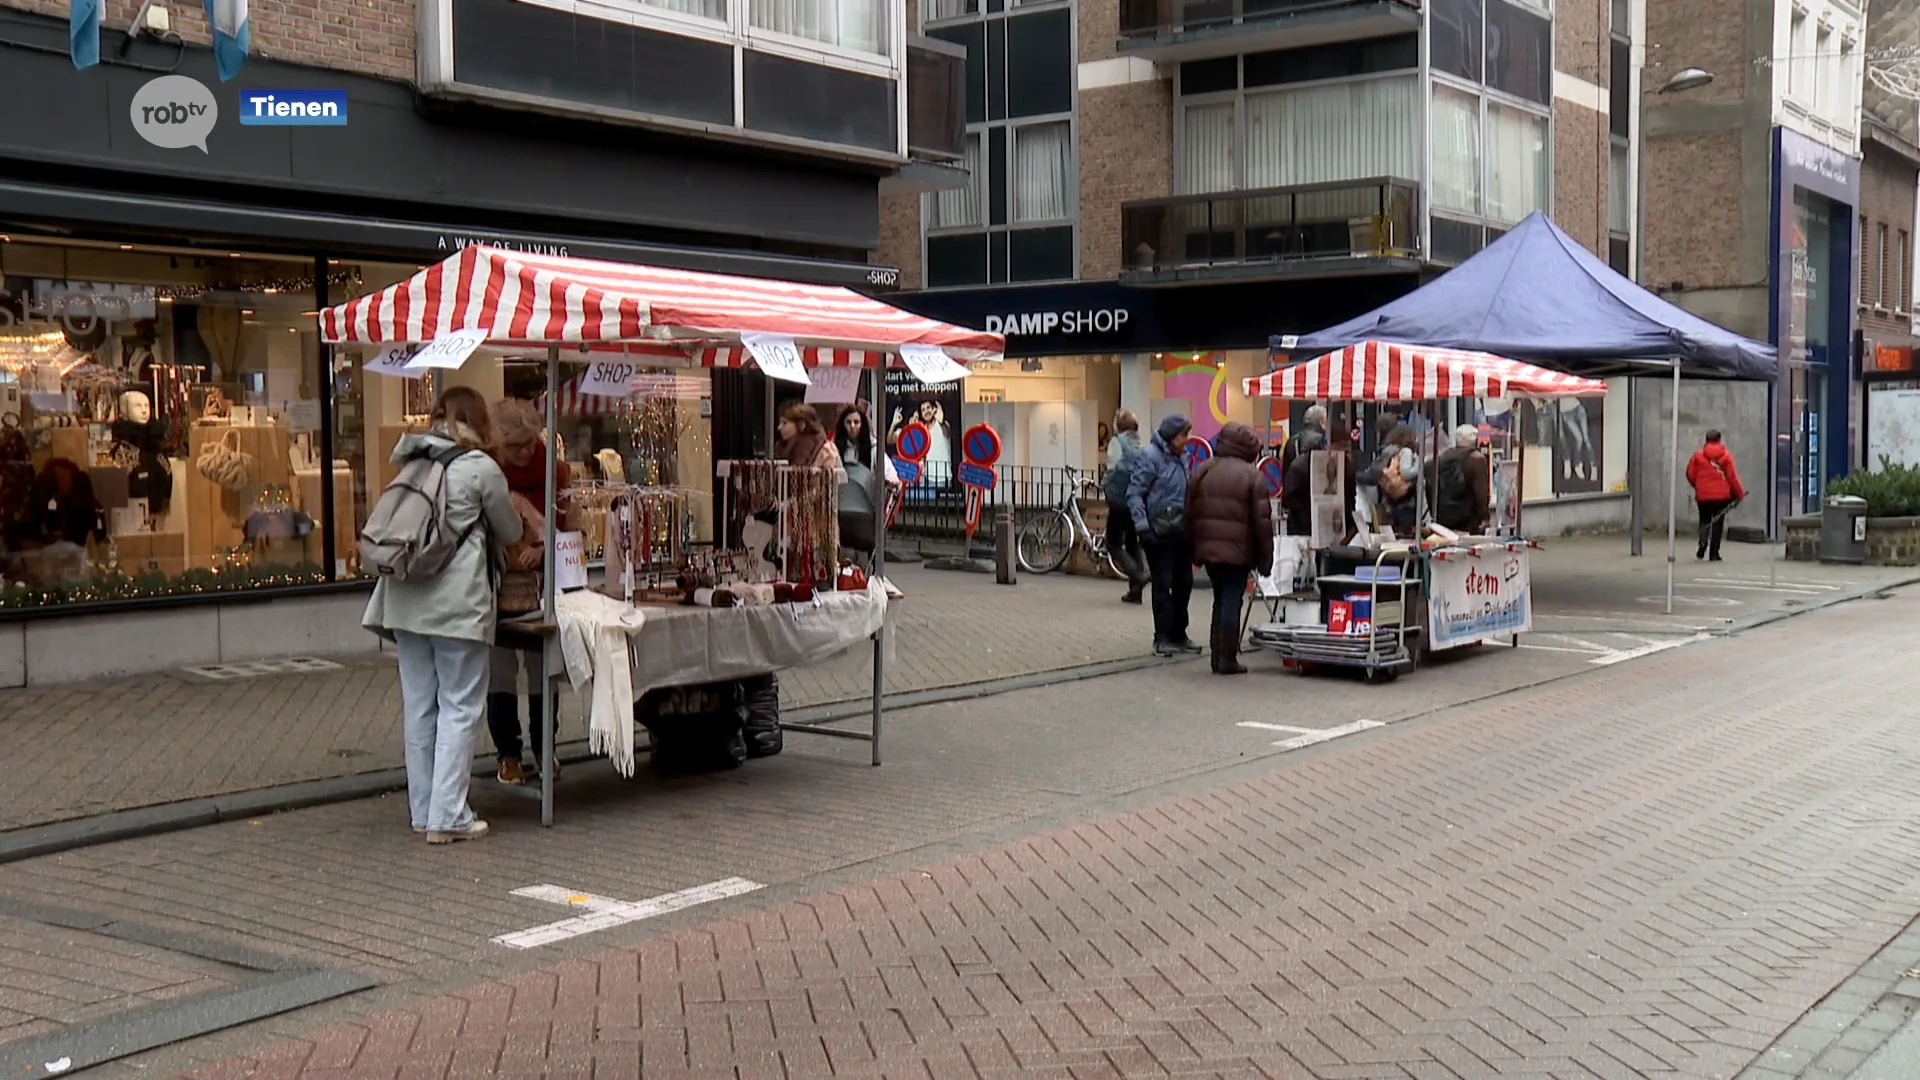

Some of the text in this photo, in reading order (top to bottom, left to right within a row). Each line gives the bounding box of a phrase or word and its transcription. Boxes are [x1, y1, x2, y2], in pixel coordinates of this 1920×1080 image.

[438, 235, 447, 250] A
[752, 343, 795, 371] SHOP
[593, 362, 633, 385] SHOP
[901, 383, 919, 392] met
[921, 381, 959, 394] stoppen
